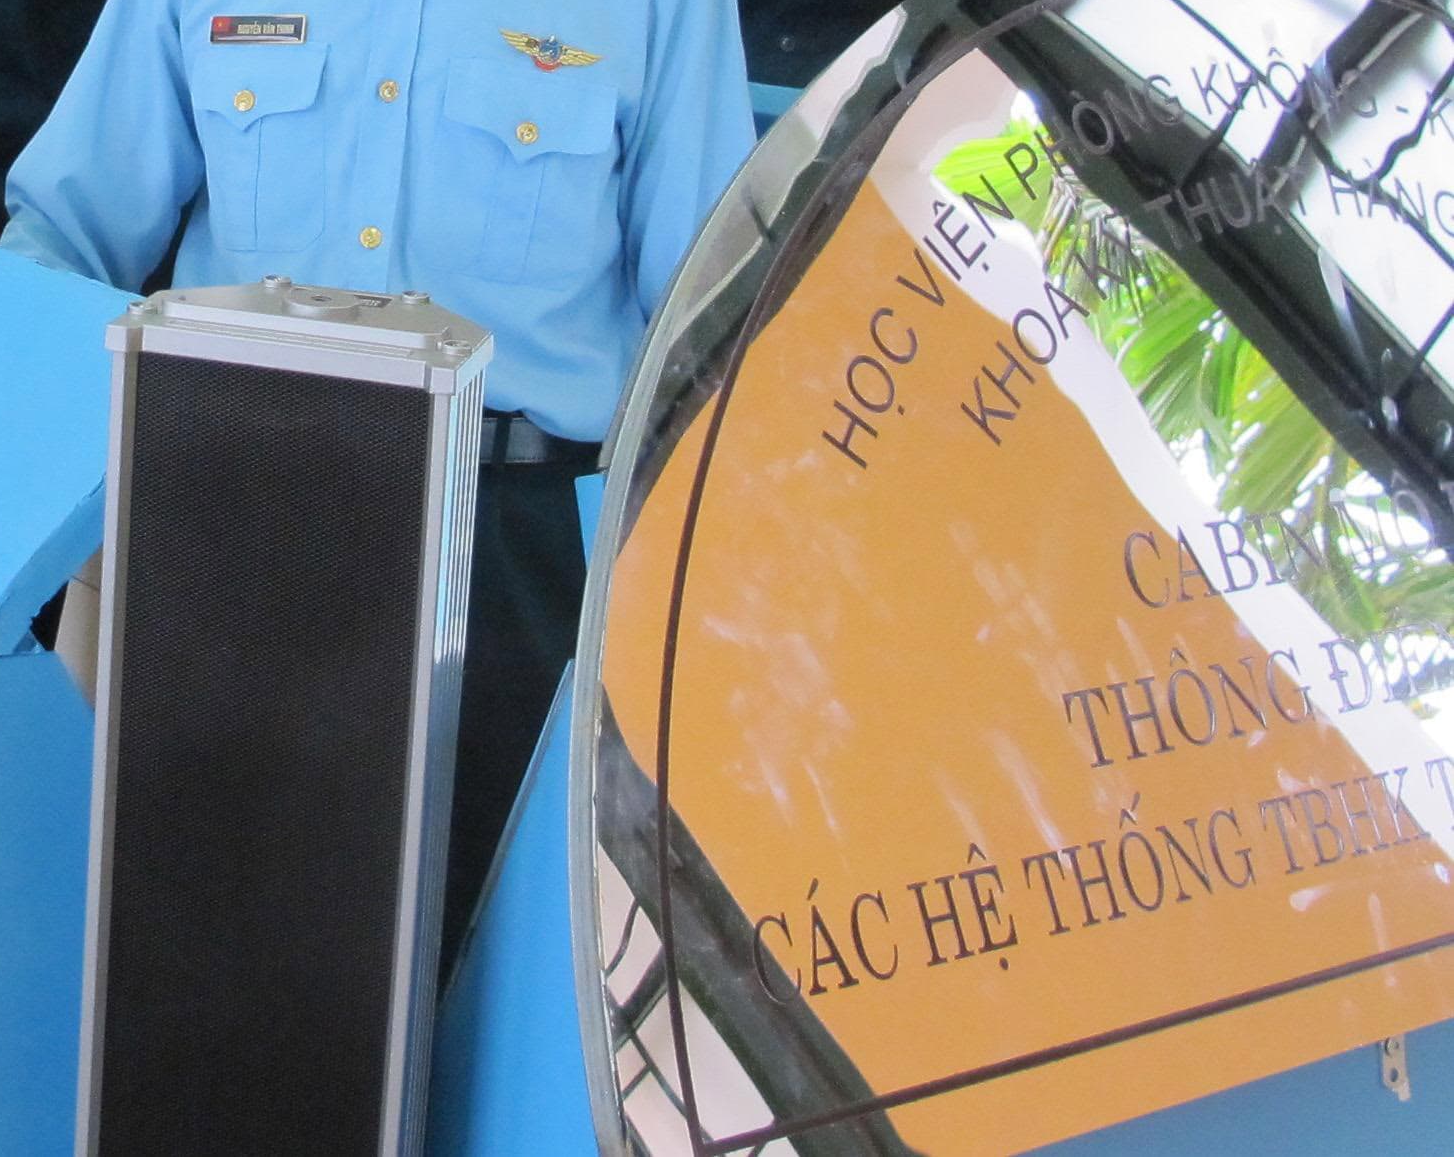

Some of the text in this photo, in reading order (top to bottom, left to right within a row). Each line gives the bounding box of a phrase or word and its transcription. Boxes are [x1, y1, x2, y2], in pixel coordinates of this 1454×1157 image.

[822, 305, 917, 469] HỌC
[897, 173, 1016, 307] VIỆN
[961, 281, 1091, 446] KHOA
[1124, 504, 1331, 609] CABIN
[1062, 647, 1315, 769] THÔNG
[753, 878, 899, 1005] CÁC
[907, 843, 1018, 971] HỆ
[1022, 793, 1256, 937] THỐNG
[1257, 766, 1431, 876] TBHK
